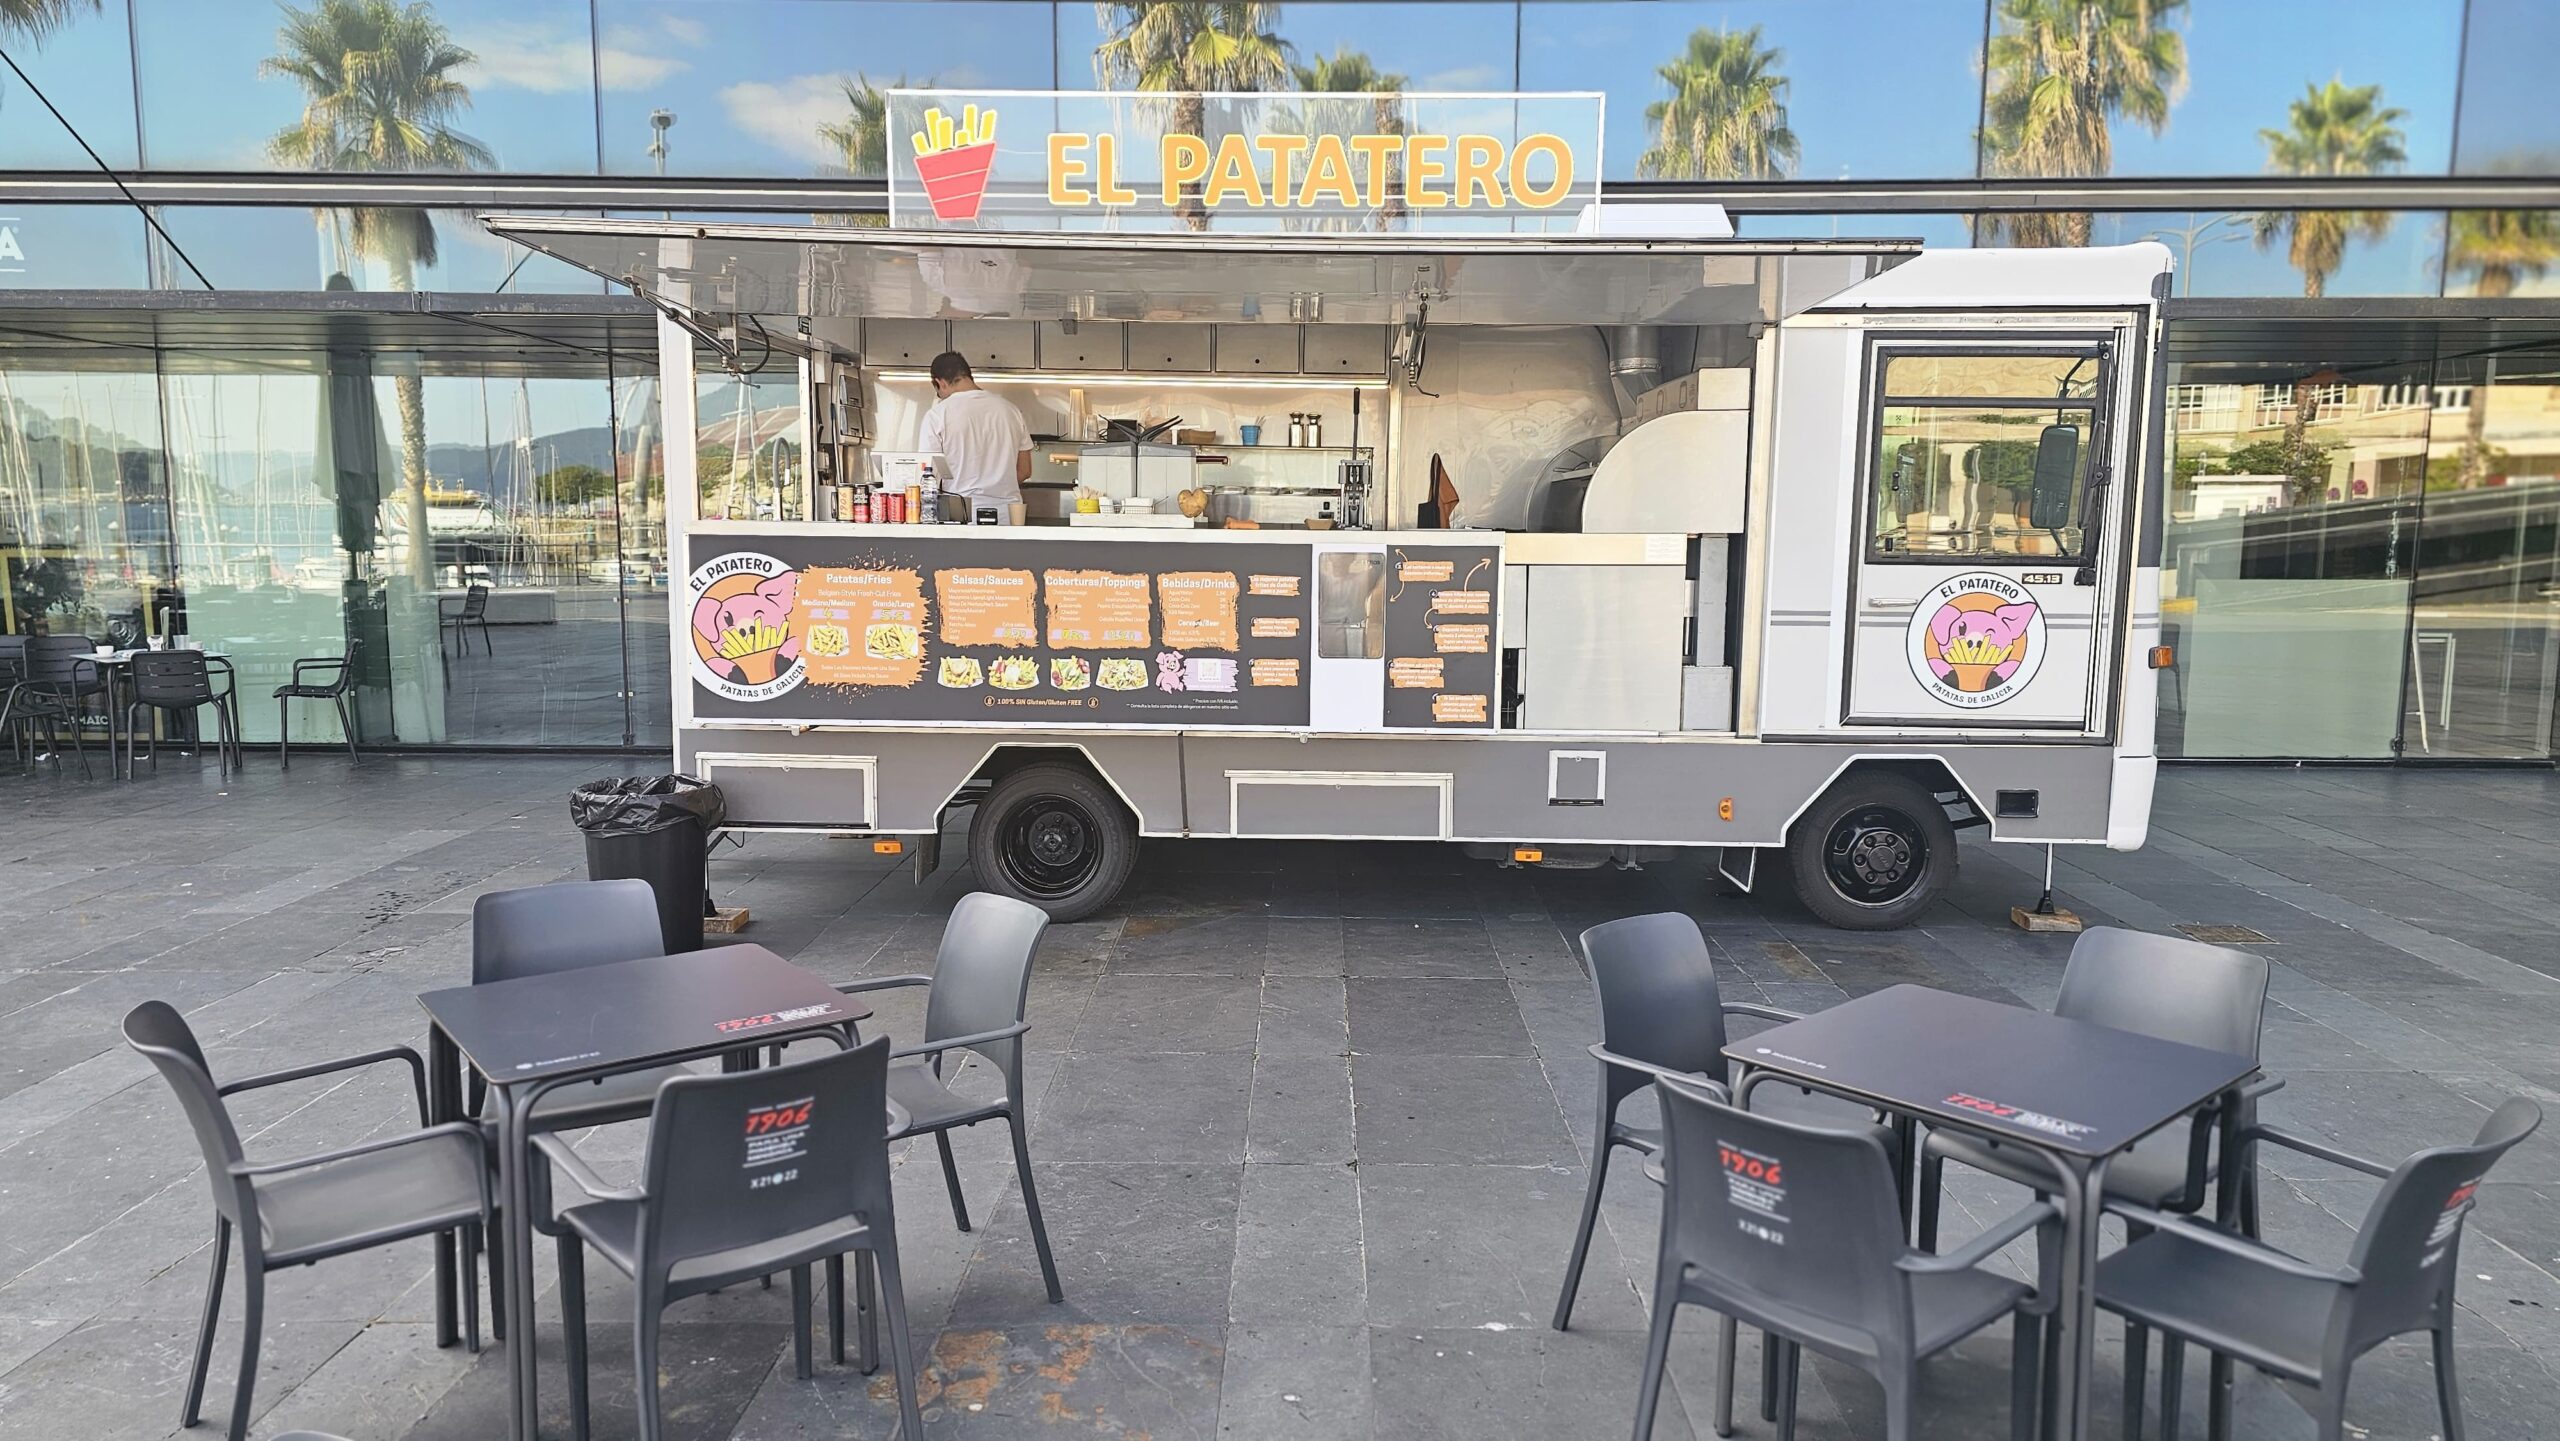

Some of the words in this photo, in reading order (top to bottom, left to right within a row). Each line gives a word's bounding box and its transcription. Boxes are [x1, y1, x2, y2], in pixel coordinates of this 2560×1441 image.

[1047, 132, 1137, 206] EL
[1161, 132, 1575, 209] PATATERO
[690, 577, 706, 591] EL
[706, 558, 772, 579] PATATERO
[827, 573, 892, 584] Patatas/Fries
[952, 575, 1024, 585] Salsas/Sauces
[1045, 576, 1146, 588] Coberturas/Toppings
[1162, 577, 1235, 589] Bebidas/Drinks
[2023, 574, 2060, 583] 45.13
[1940, 585, 1956, 598] EL
[1959, 578, 2019, 599] PATATERO
[872, 600, 915, 608] Grande/Large
[720, 683, 759, 698] PATATAS
[762, 686, 774, 696] DE
[776, 664, 806, 691] GALICIA
[1932, 682, 1964, 702] PATATAS
[1981, 685, 2013, 703] GALICIA
[746, 1102, 814, 1134] 1906
[1719, 1148, 1782, 1185] 1906
